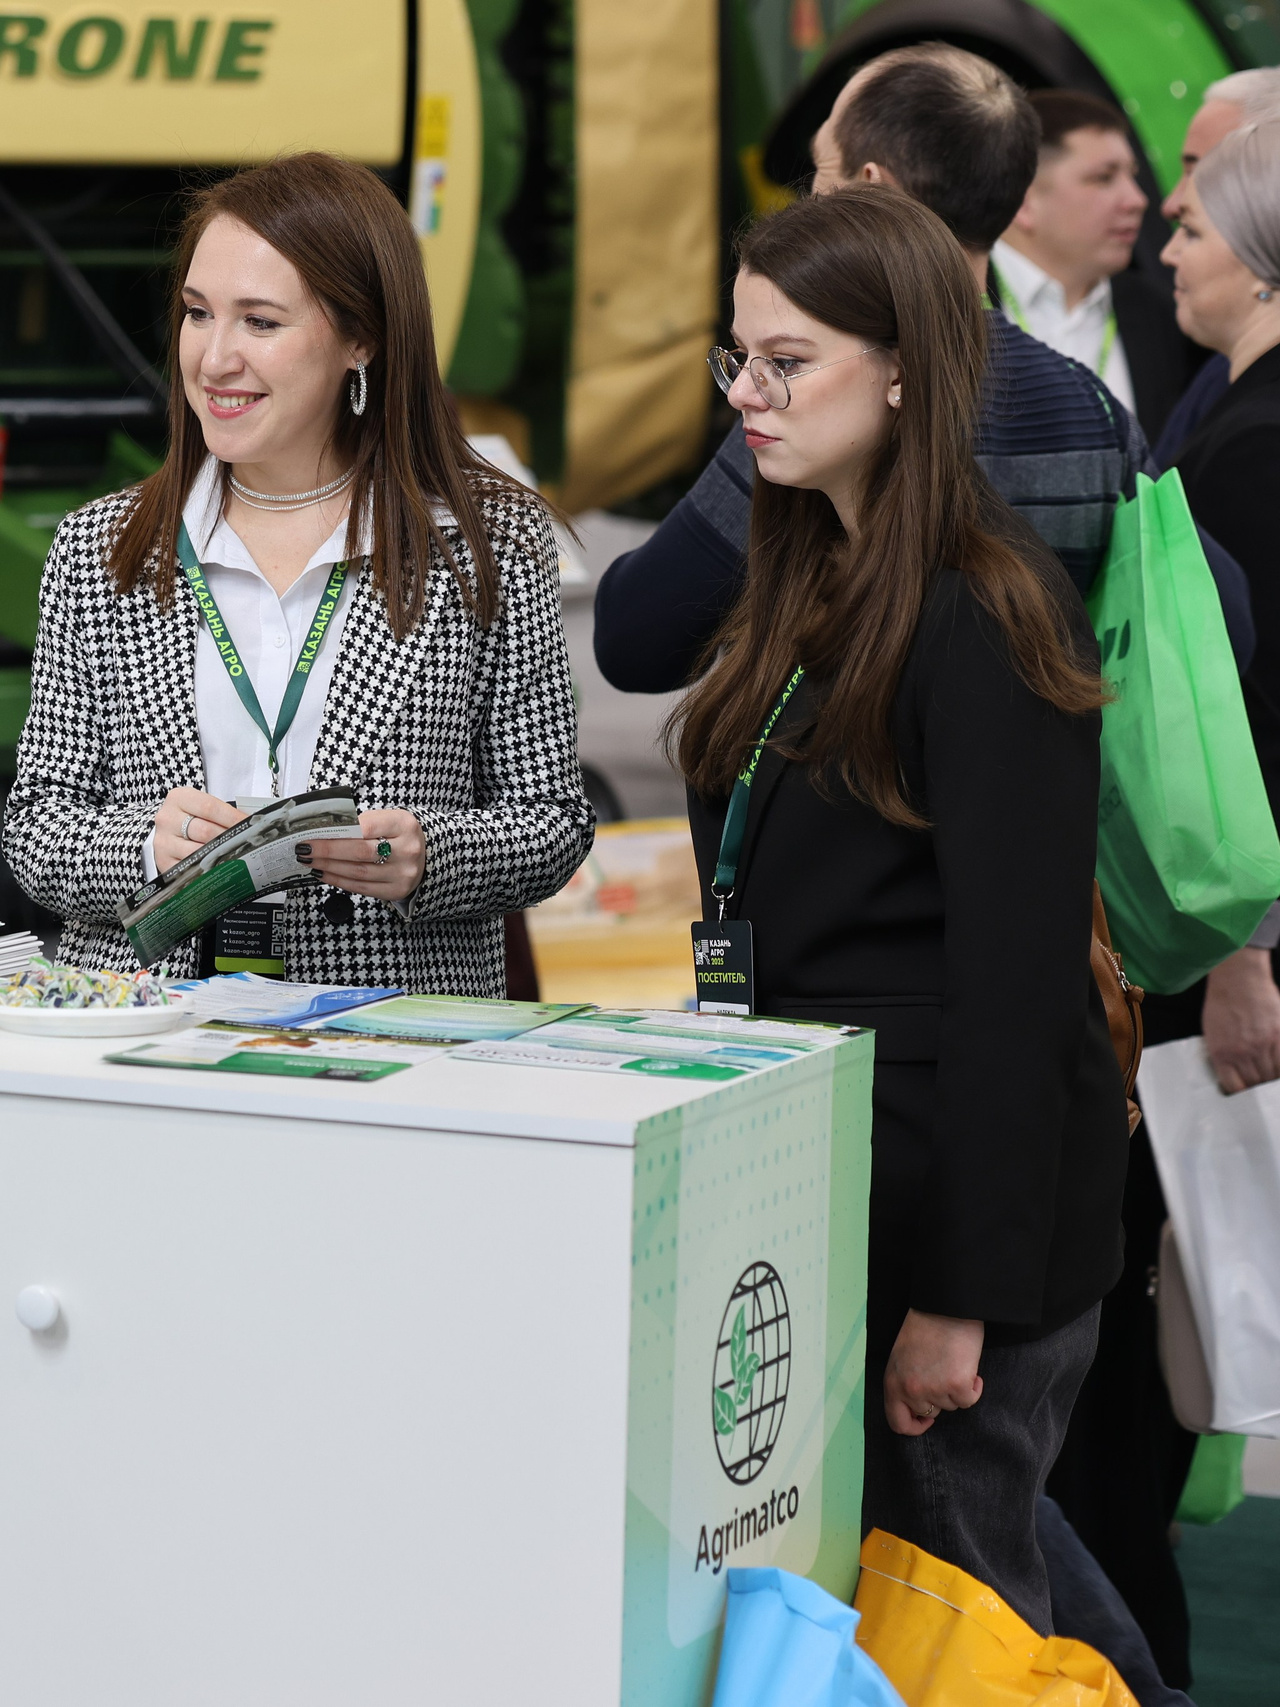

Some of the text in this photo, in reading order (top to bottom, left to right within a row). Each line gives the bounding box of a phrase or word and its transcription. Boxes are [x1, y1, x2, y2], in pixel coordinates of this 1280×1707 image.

[302, 560, 350, 660] КАЗАНЬ АГРО
[193, 579, 243, 678] КАЗАНЬ АГРО
[709, 939, 732, 948] КАЗАНЬ
[710, 948, 725, 956] АГРО
[710, 957, 725, 966] 2025
[697, 972, 747, 984] ПОСЕТИТЕЛЬ
[694, 1485, 800, 1576] Agrimatco
